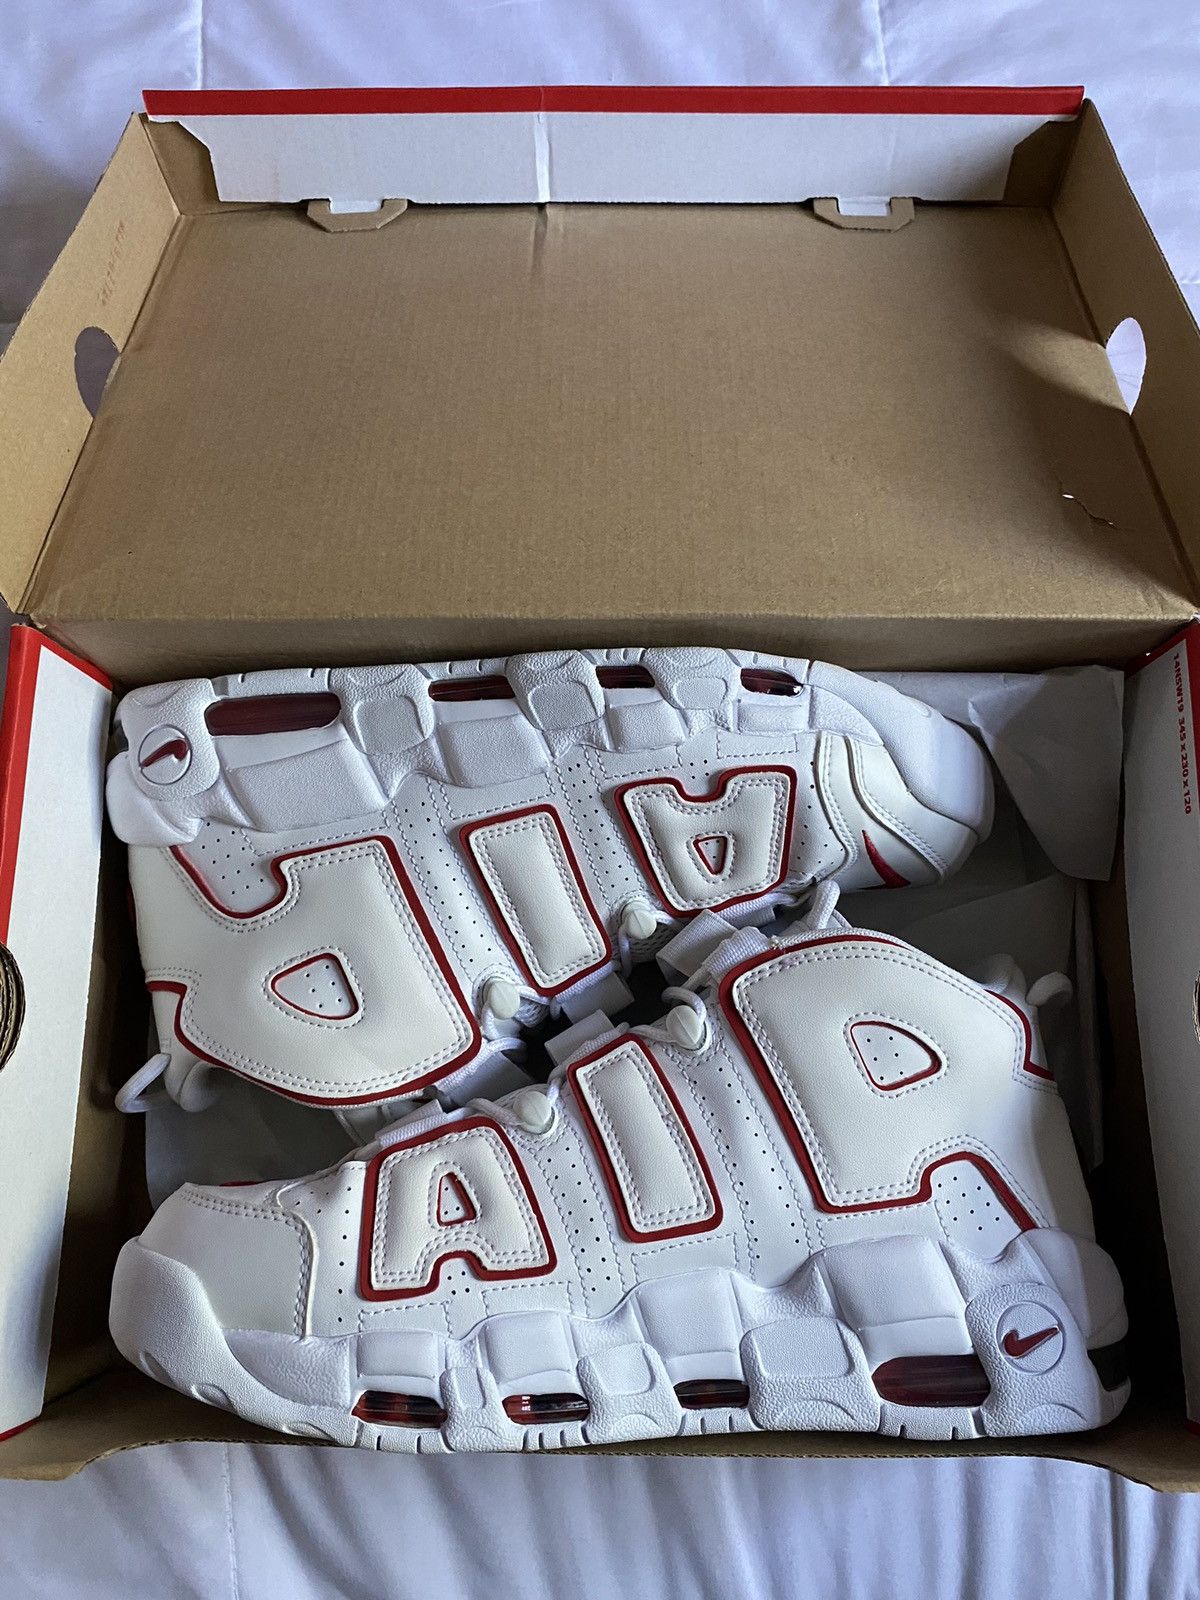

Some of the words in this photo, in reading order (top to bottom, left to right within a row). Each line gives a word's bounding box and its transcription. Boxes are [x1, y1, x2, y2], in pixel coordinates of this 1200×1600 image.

[1178, 717, 1187, 741] 345
[1181, 753, 1189, 778] 230
[1184, 790, 1192, 814] 120
[359, 933, 1054, 1302] AIR
